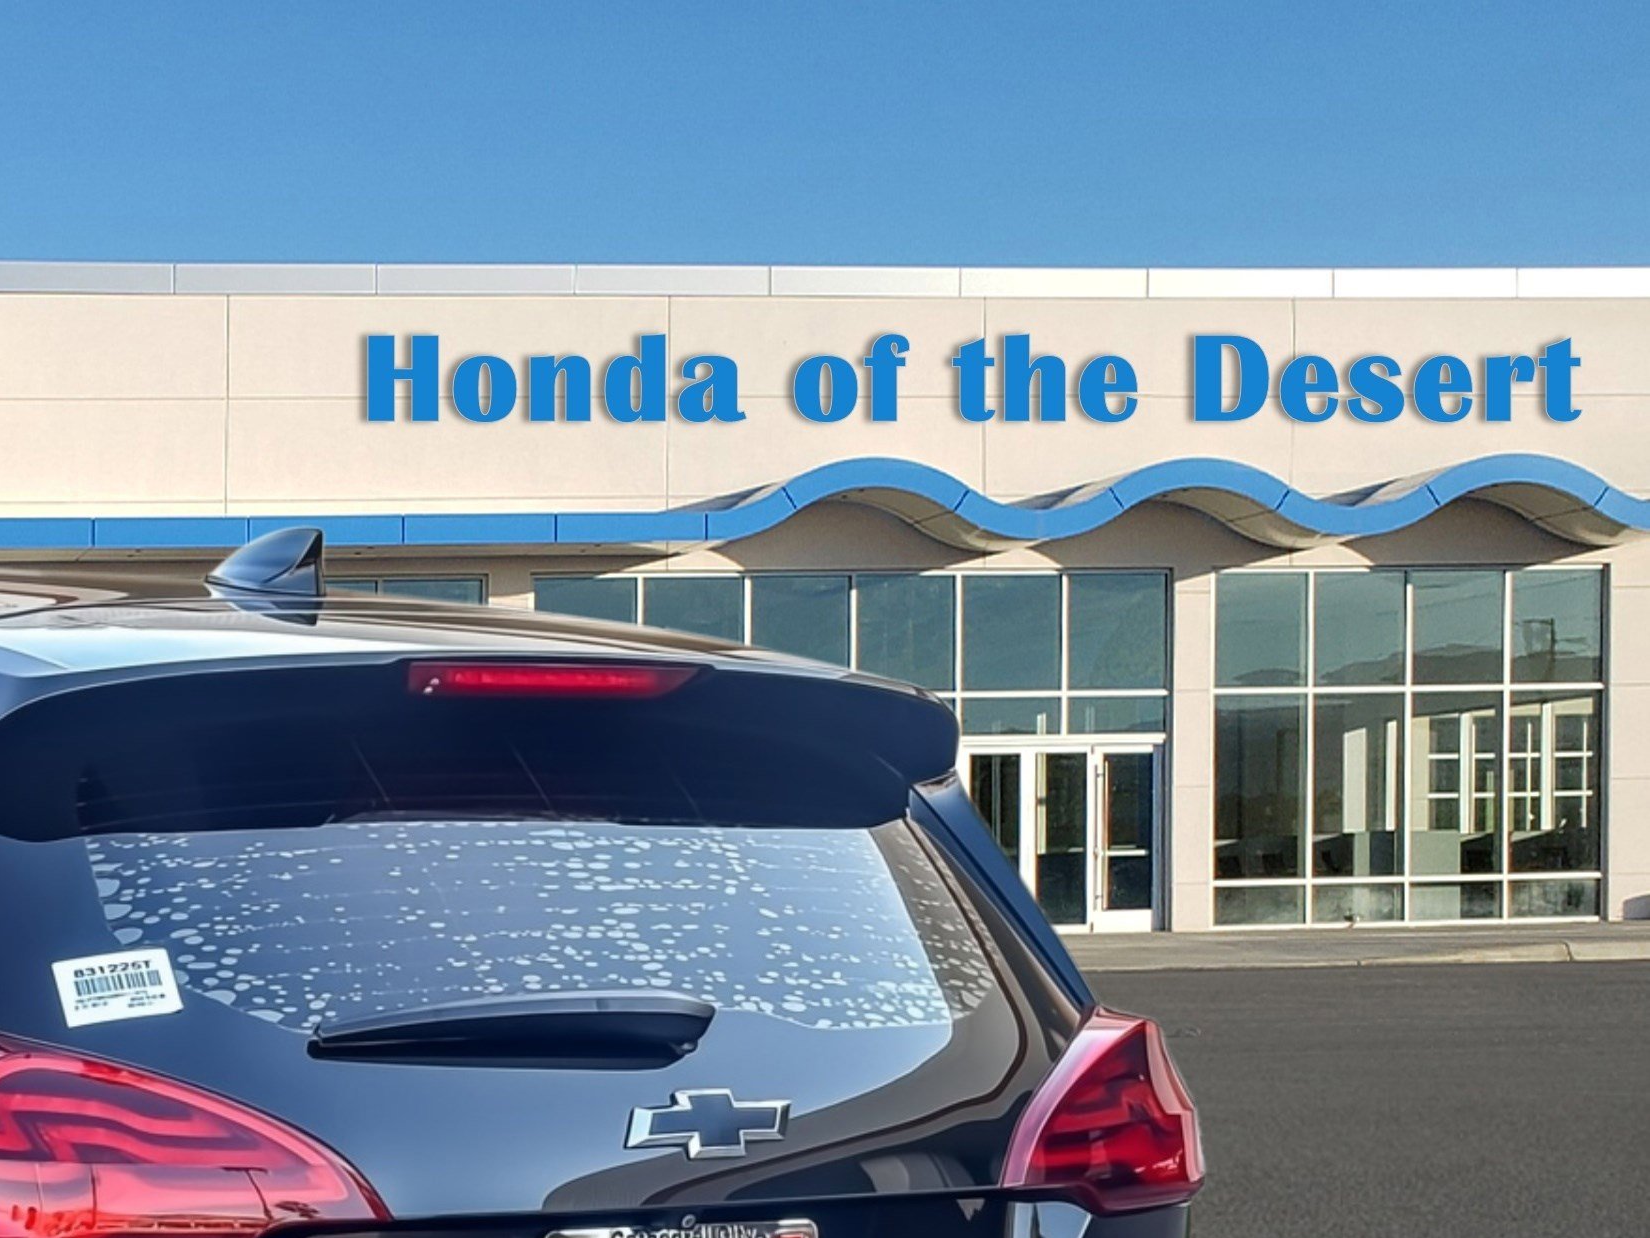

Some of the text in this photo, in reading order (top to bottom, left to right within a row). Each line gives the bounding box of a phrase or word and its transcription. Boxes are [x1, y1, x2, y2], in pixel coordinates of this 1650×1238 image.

[366, 332, 1583, 424] Honda of the Desert
